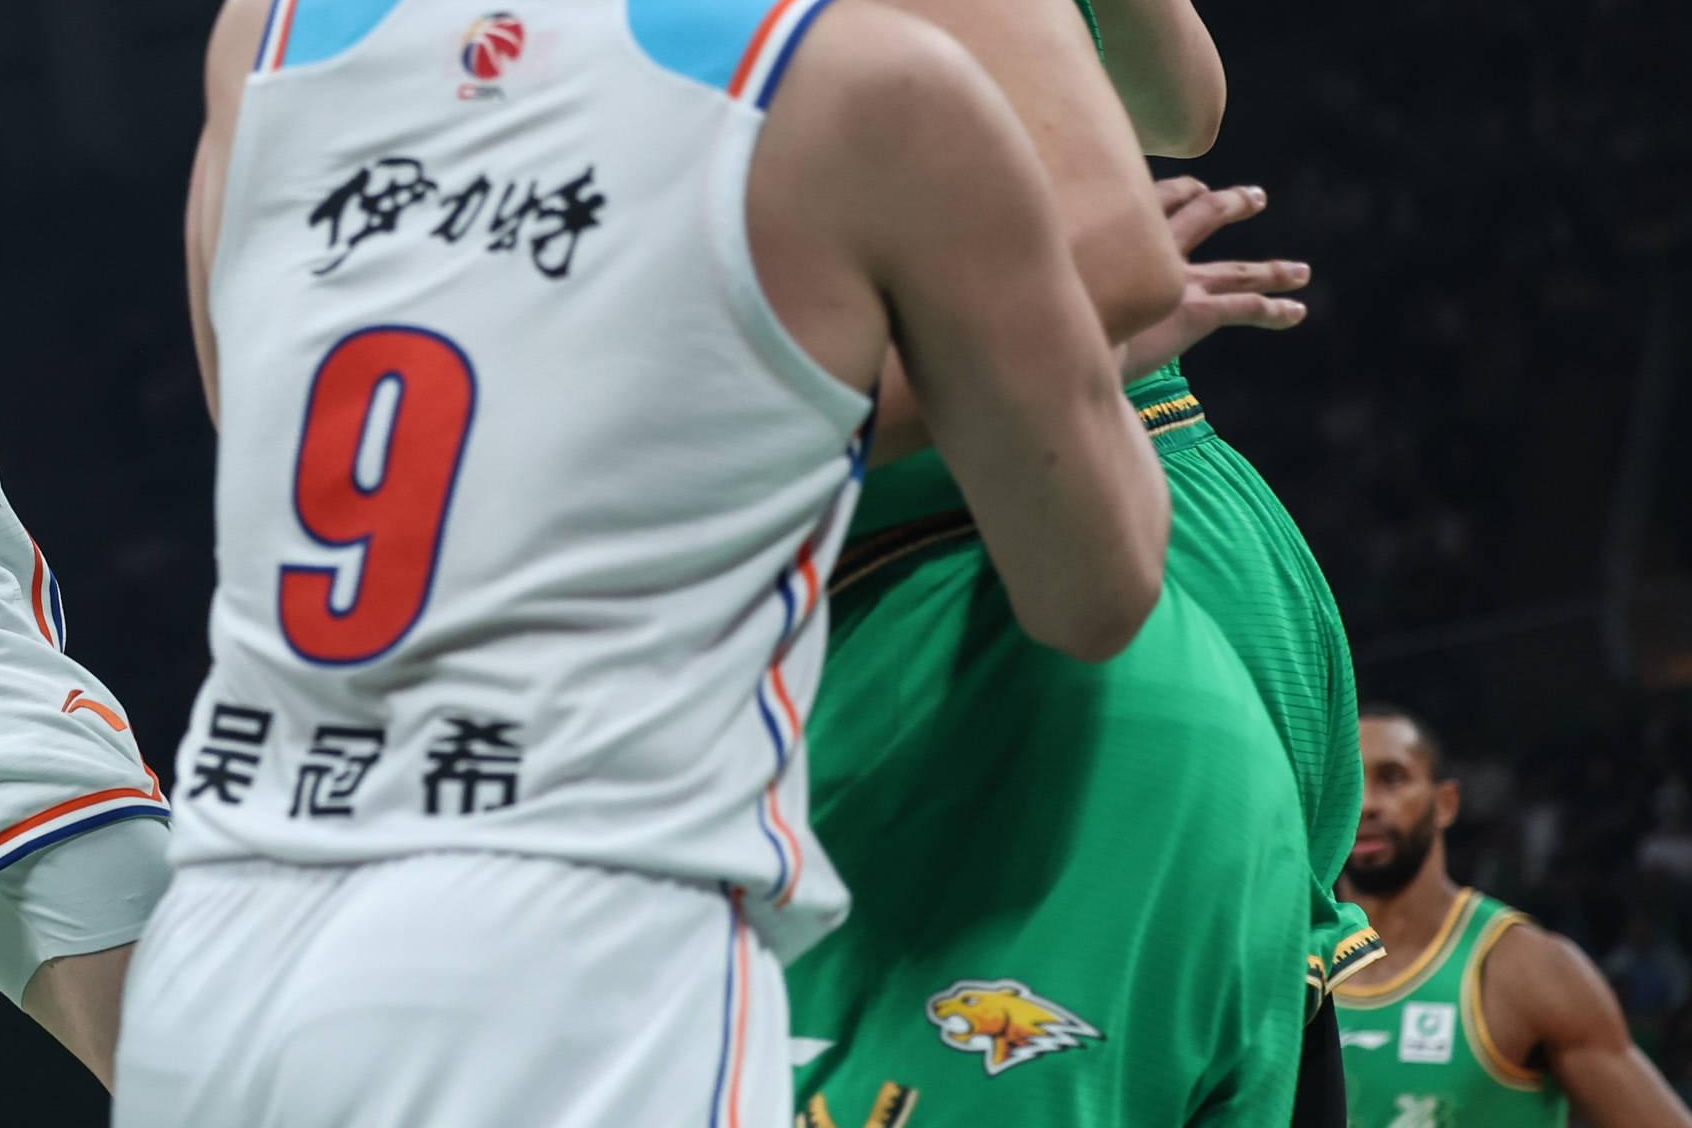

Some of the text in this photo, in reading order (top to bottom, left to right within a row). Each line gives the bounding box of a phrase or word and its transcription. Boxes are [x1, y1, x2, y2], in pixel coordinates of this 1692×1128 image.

[277, 324, 477, 667] 9
[188, 704, 525, 818] 吴冠希
